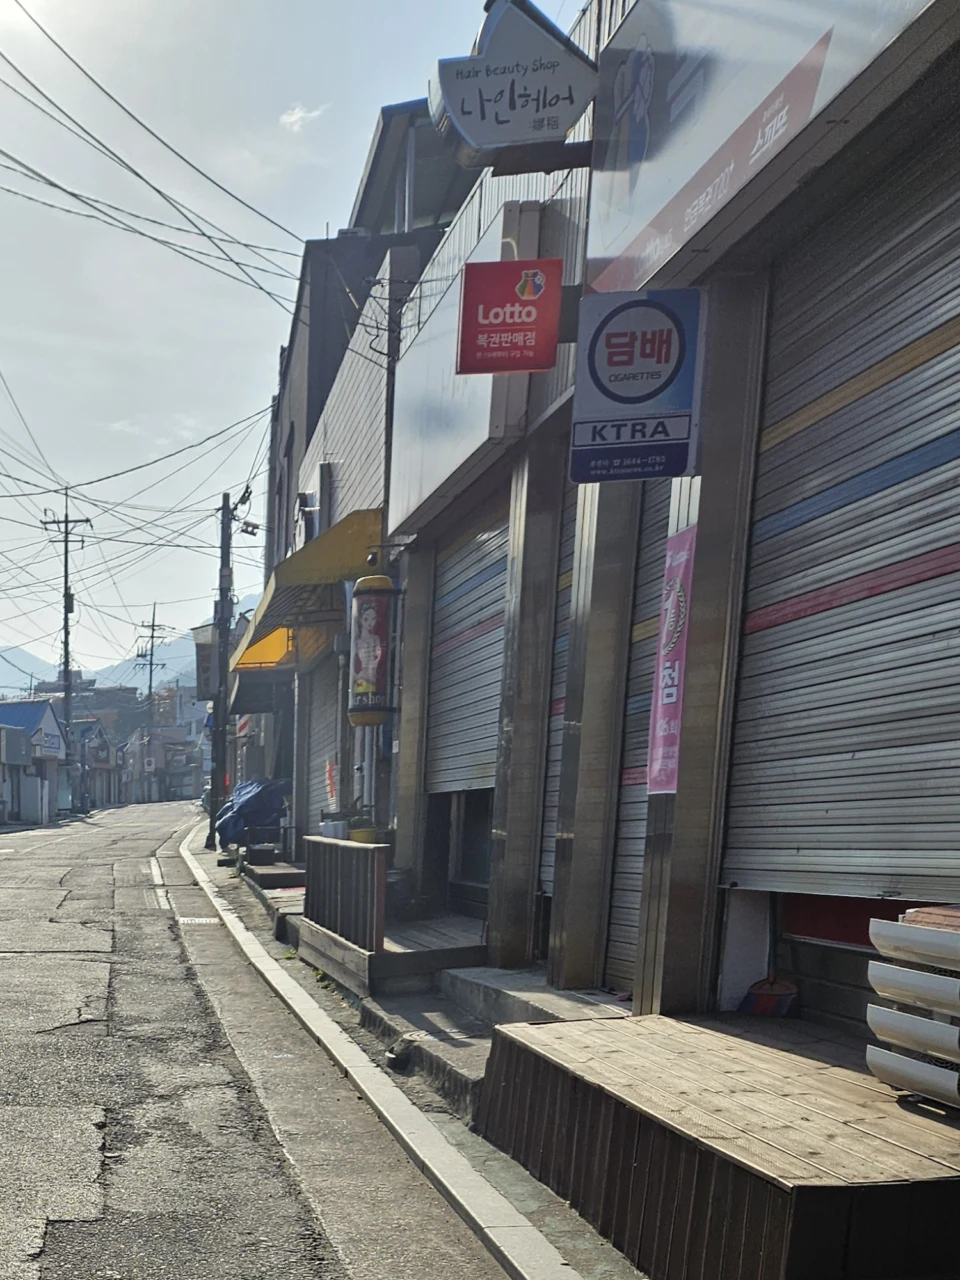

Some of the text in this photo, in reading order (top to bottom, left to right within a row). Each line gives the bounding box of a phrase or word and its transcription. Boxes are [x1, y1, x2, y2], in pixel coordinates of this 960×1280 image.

[456, 67, 481, 80] Hair
[532, 56, 560, 74] Shop
[461, 78, 575, 125] 나인헤어
[478, 303, 537, 325] Lotto
[476, 331, 536, 348] 복권판매점
[605, 328, 672, 367] 담배
[591, 421, 670, 442] KTRA
